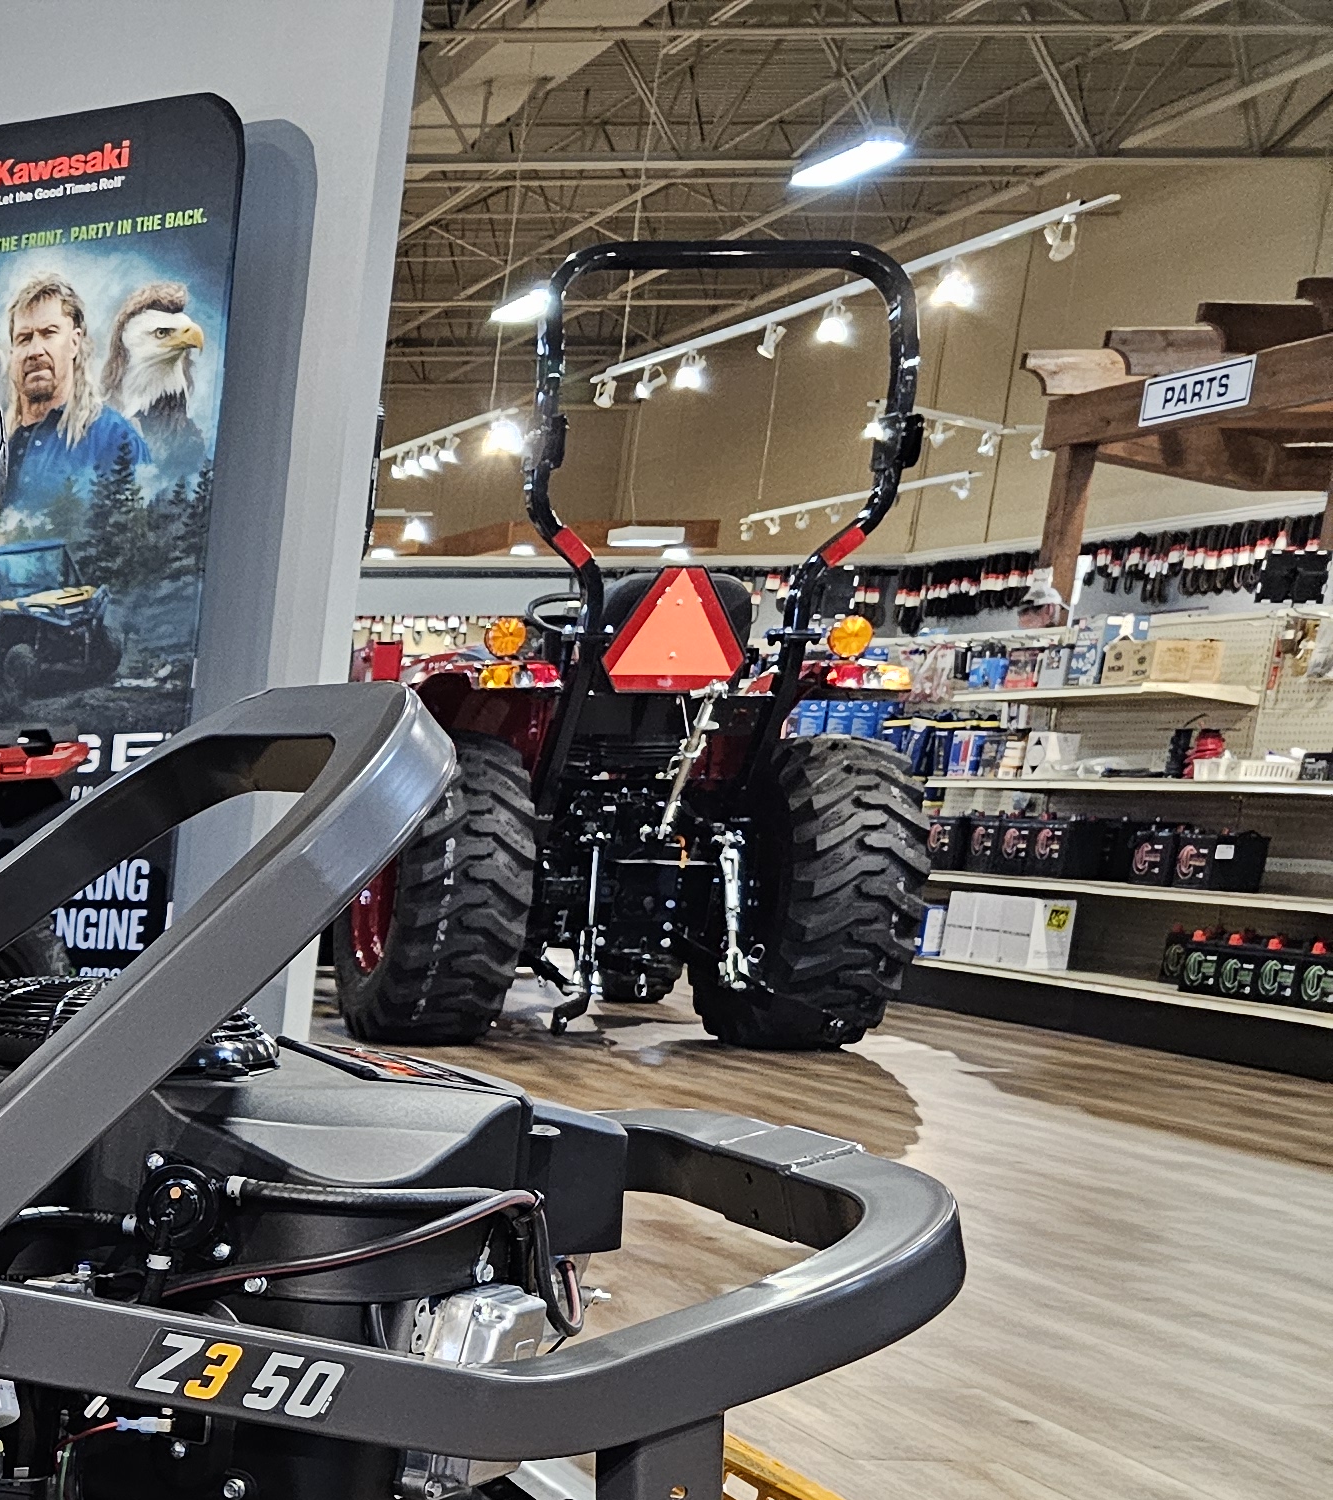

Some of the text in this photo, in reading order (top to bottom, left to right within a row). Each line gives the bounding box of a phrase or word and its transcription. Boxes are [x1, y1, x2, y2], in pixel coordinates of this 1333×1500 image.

[16, 189, 33, 203] the
[34, 185, 64, 201] Good
[65, 180, 97, 195] Times
[20, 228, 67, 250] FRONT.
[70, 221, 115, 243] PARTY
[117, 218, 133, 236] IN
[136, 214, 162, 234] THE
[165, 207, 208, 230] BACK.
[1161, 373, 1231, 411] PARTS
[51, 907, 149, 951] NGINE
